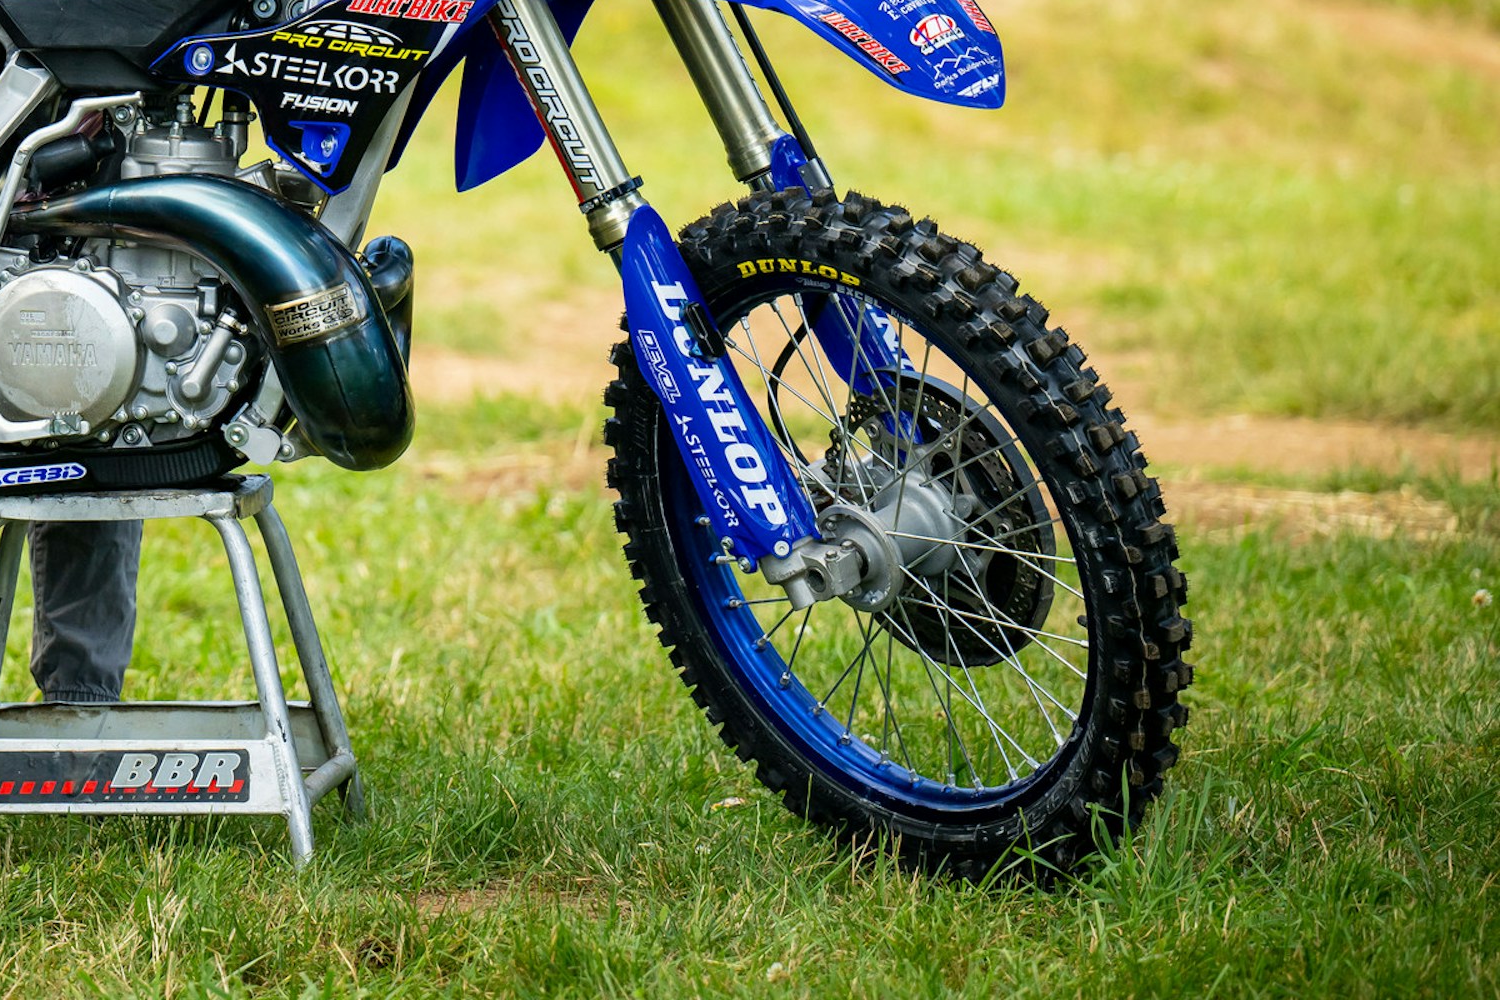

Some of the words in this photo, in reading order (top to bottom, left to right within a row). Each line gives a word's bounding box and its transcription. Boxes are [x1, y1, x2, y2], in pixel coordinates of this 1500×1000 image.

[271, 31, 327, 49] PRO
[327, 40, 430, 61] CIRCUIT
[251, 52, 399, 93] STEELKORR
[281, 92, 359, 114] FUSION
[525, 66, 605, 191] CIRCUIT
[737, 258, 861, 286] DUNLOP
[273, 302, 310, 318] PRO
[279, 320, 321, 338] Works
[8, 342, 97, 367] YAMAHA
[638, 329, 681, 404] DEVOL
[685, 433, 739, 528] STEELKORR
[110, 753, 240, 788] BBR
